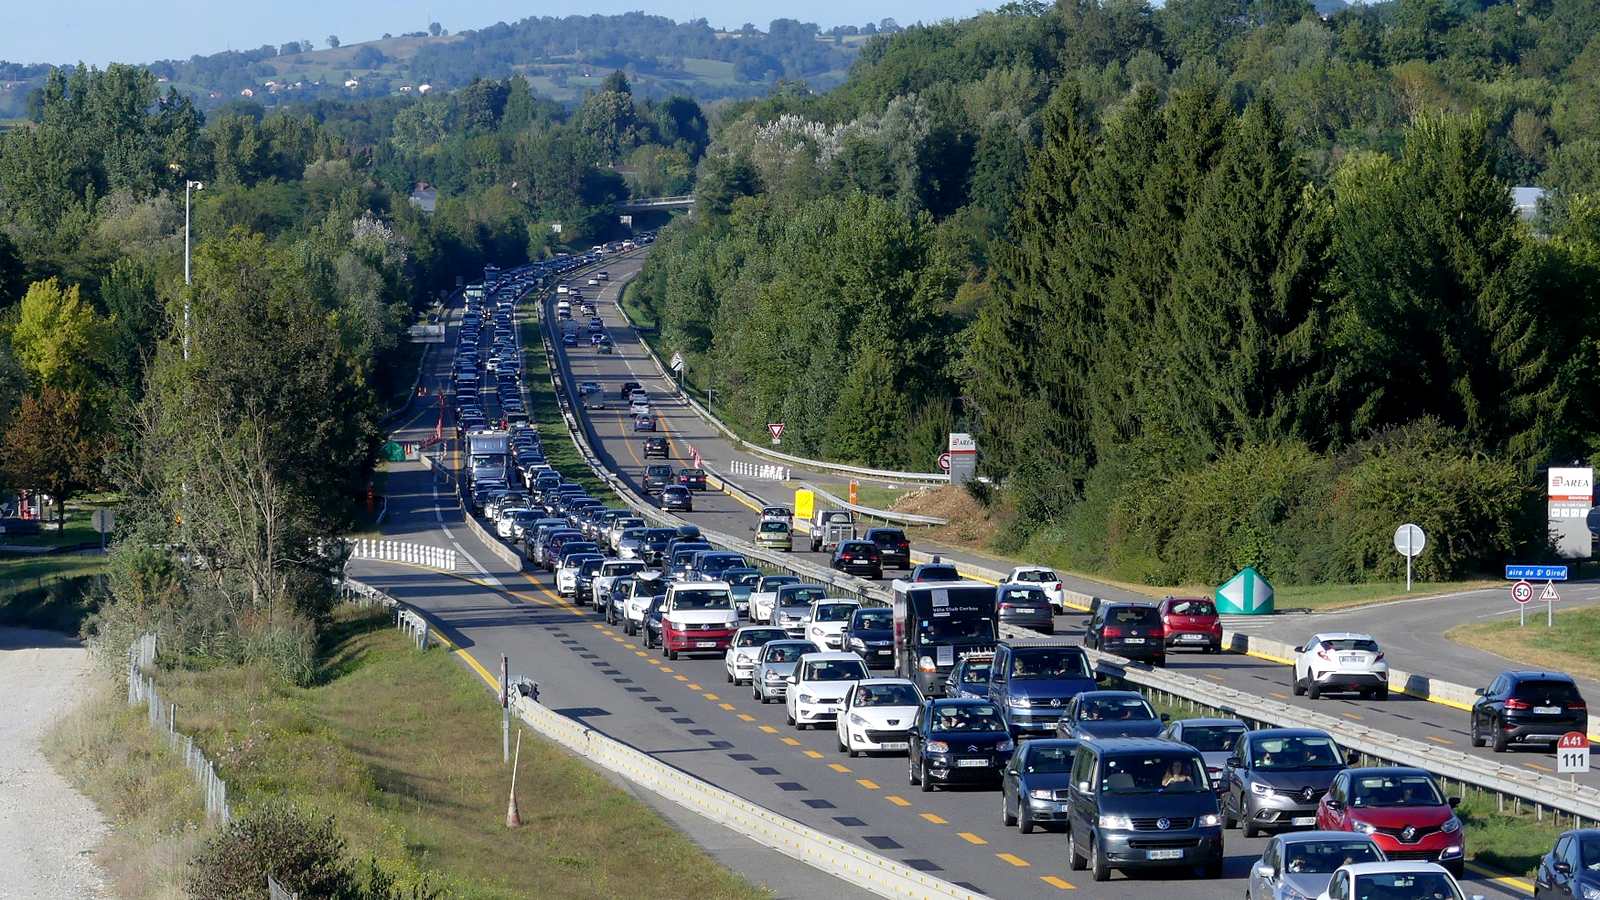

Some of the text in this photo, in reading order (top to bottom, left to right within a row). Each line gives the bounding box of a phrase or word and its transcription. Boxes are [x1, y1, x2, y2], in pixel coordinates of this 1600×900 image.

[1564, 479, 1589, 487] AREA
[1525, 568, 1534, 576] de
[1516, 588, 1530, 597] 50
[1563, 736, 1582, 746] A 41
[1562, 753, 1584, 767] 111
